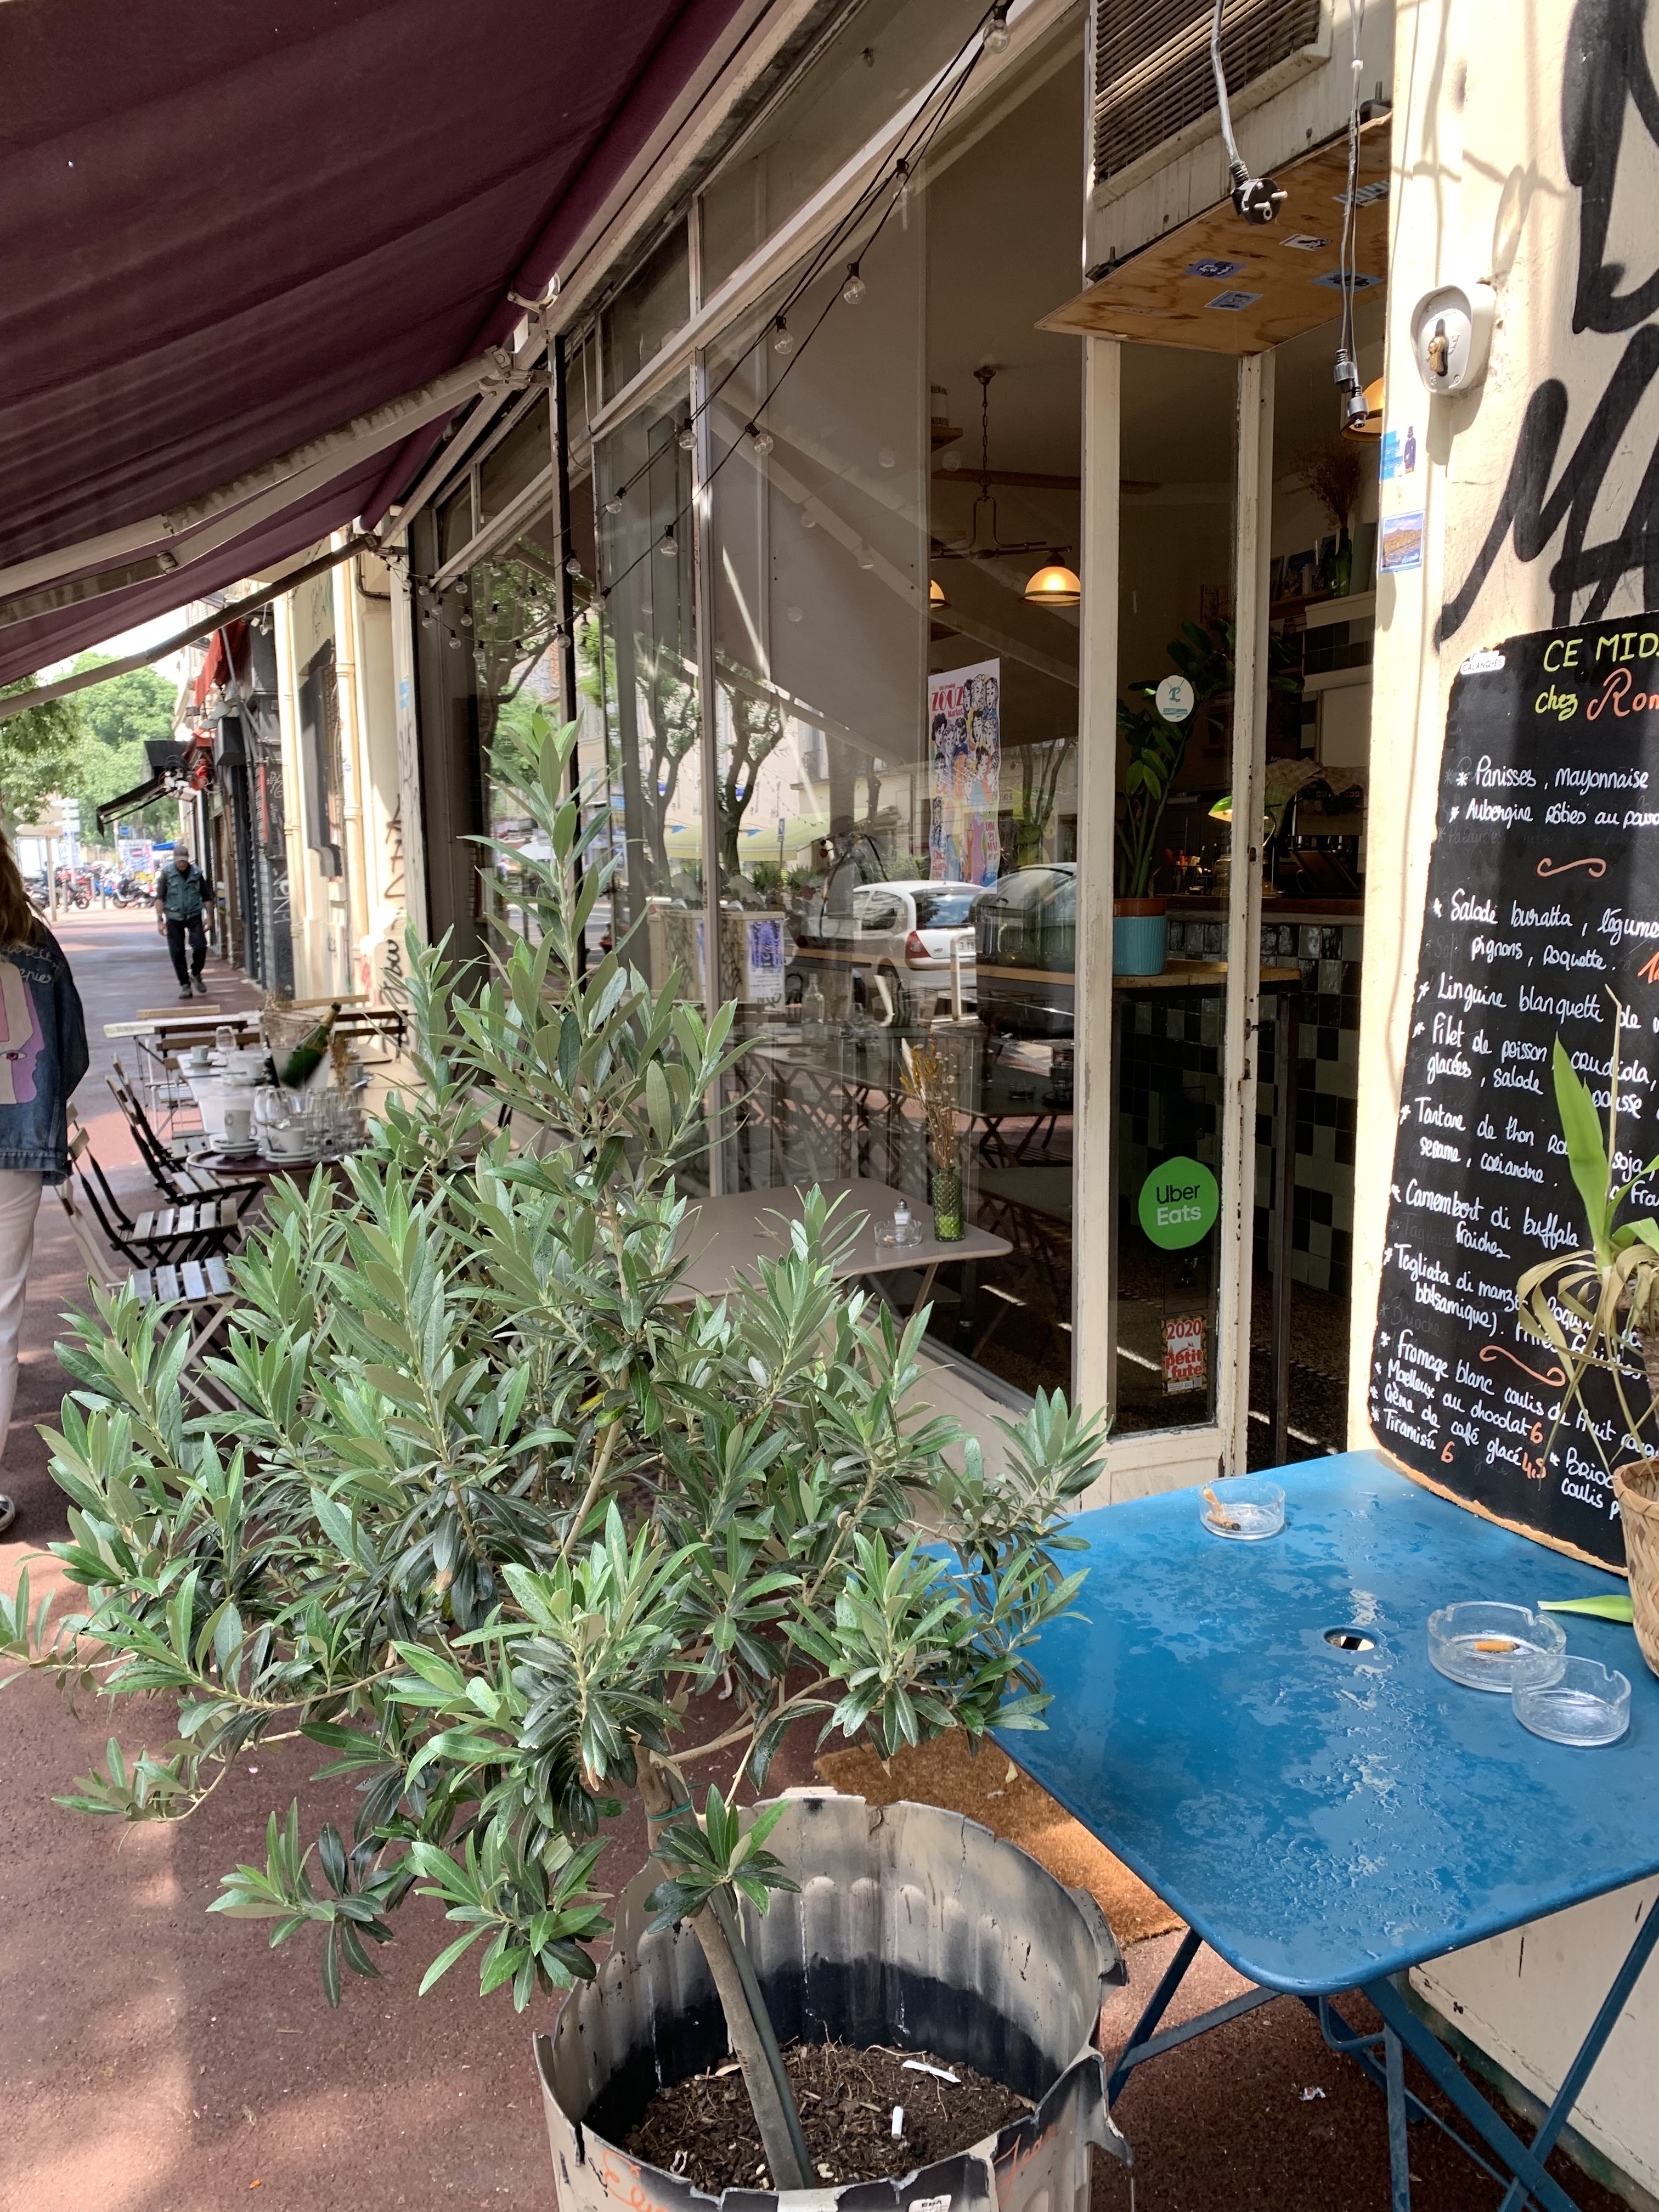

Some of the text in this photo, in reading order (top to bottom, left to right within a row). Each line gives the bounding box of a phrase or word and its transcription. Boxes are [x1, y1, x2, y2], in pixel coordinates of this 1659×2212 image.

[1463, 659, 1503, 672] CALANQUES
[1543, 632, 1659, 672] CE MID
[932, 686, 964, 712] ZOUZ
[1536, 667, 1659, 721] chez Ron
[1476, 755, 1537, 787] Panisses
[1466, 798, 1533, 829] Aubergine
[1595, 810, 1620, 825] au
[1623, 810, 1659, 830] pavo
[1451, 888, 1498, 924] Salade
[1597, 908, 1659, 946] légume
[1437, 972, 1507, 1012] Linguine
[1472, 1029, 1492, 1054] de
[1502, 1040, 1547, 1063] poisson
[1415, 1097, 1466, 1132] Tartare
[1477, 1113, 1497, 1139] de
[1505, 1115, 1534, 1147] thon
[1156, 1185, 1200, 1204] Uber
[1157, 1205, 1201, 1226] Eats
[1491, 1206, 1511, 1231] di
[1523, 1207, 1580, 1250] buffala
[1456, 1271, 1474, 1293] di
[1166, 1319, 1202, 1340] 2020
[1165, 1349, 1203, 1369] petit
[1388, 1358, 1544, 1444] Moelleux au chocolat 6
[1456, 1359, 1495, 1396] blanc
[1505, 1387, 1544, 1417] coulis
[1421, 1404, 1441, 1429] de
[1451, 1420, 1480, 1446] café
[1486, 1438, 1522, 1465] glacé
[1441, 1441, 1454, 1463] 6
[1561, 1477, 1603, 1509] coulis
